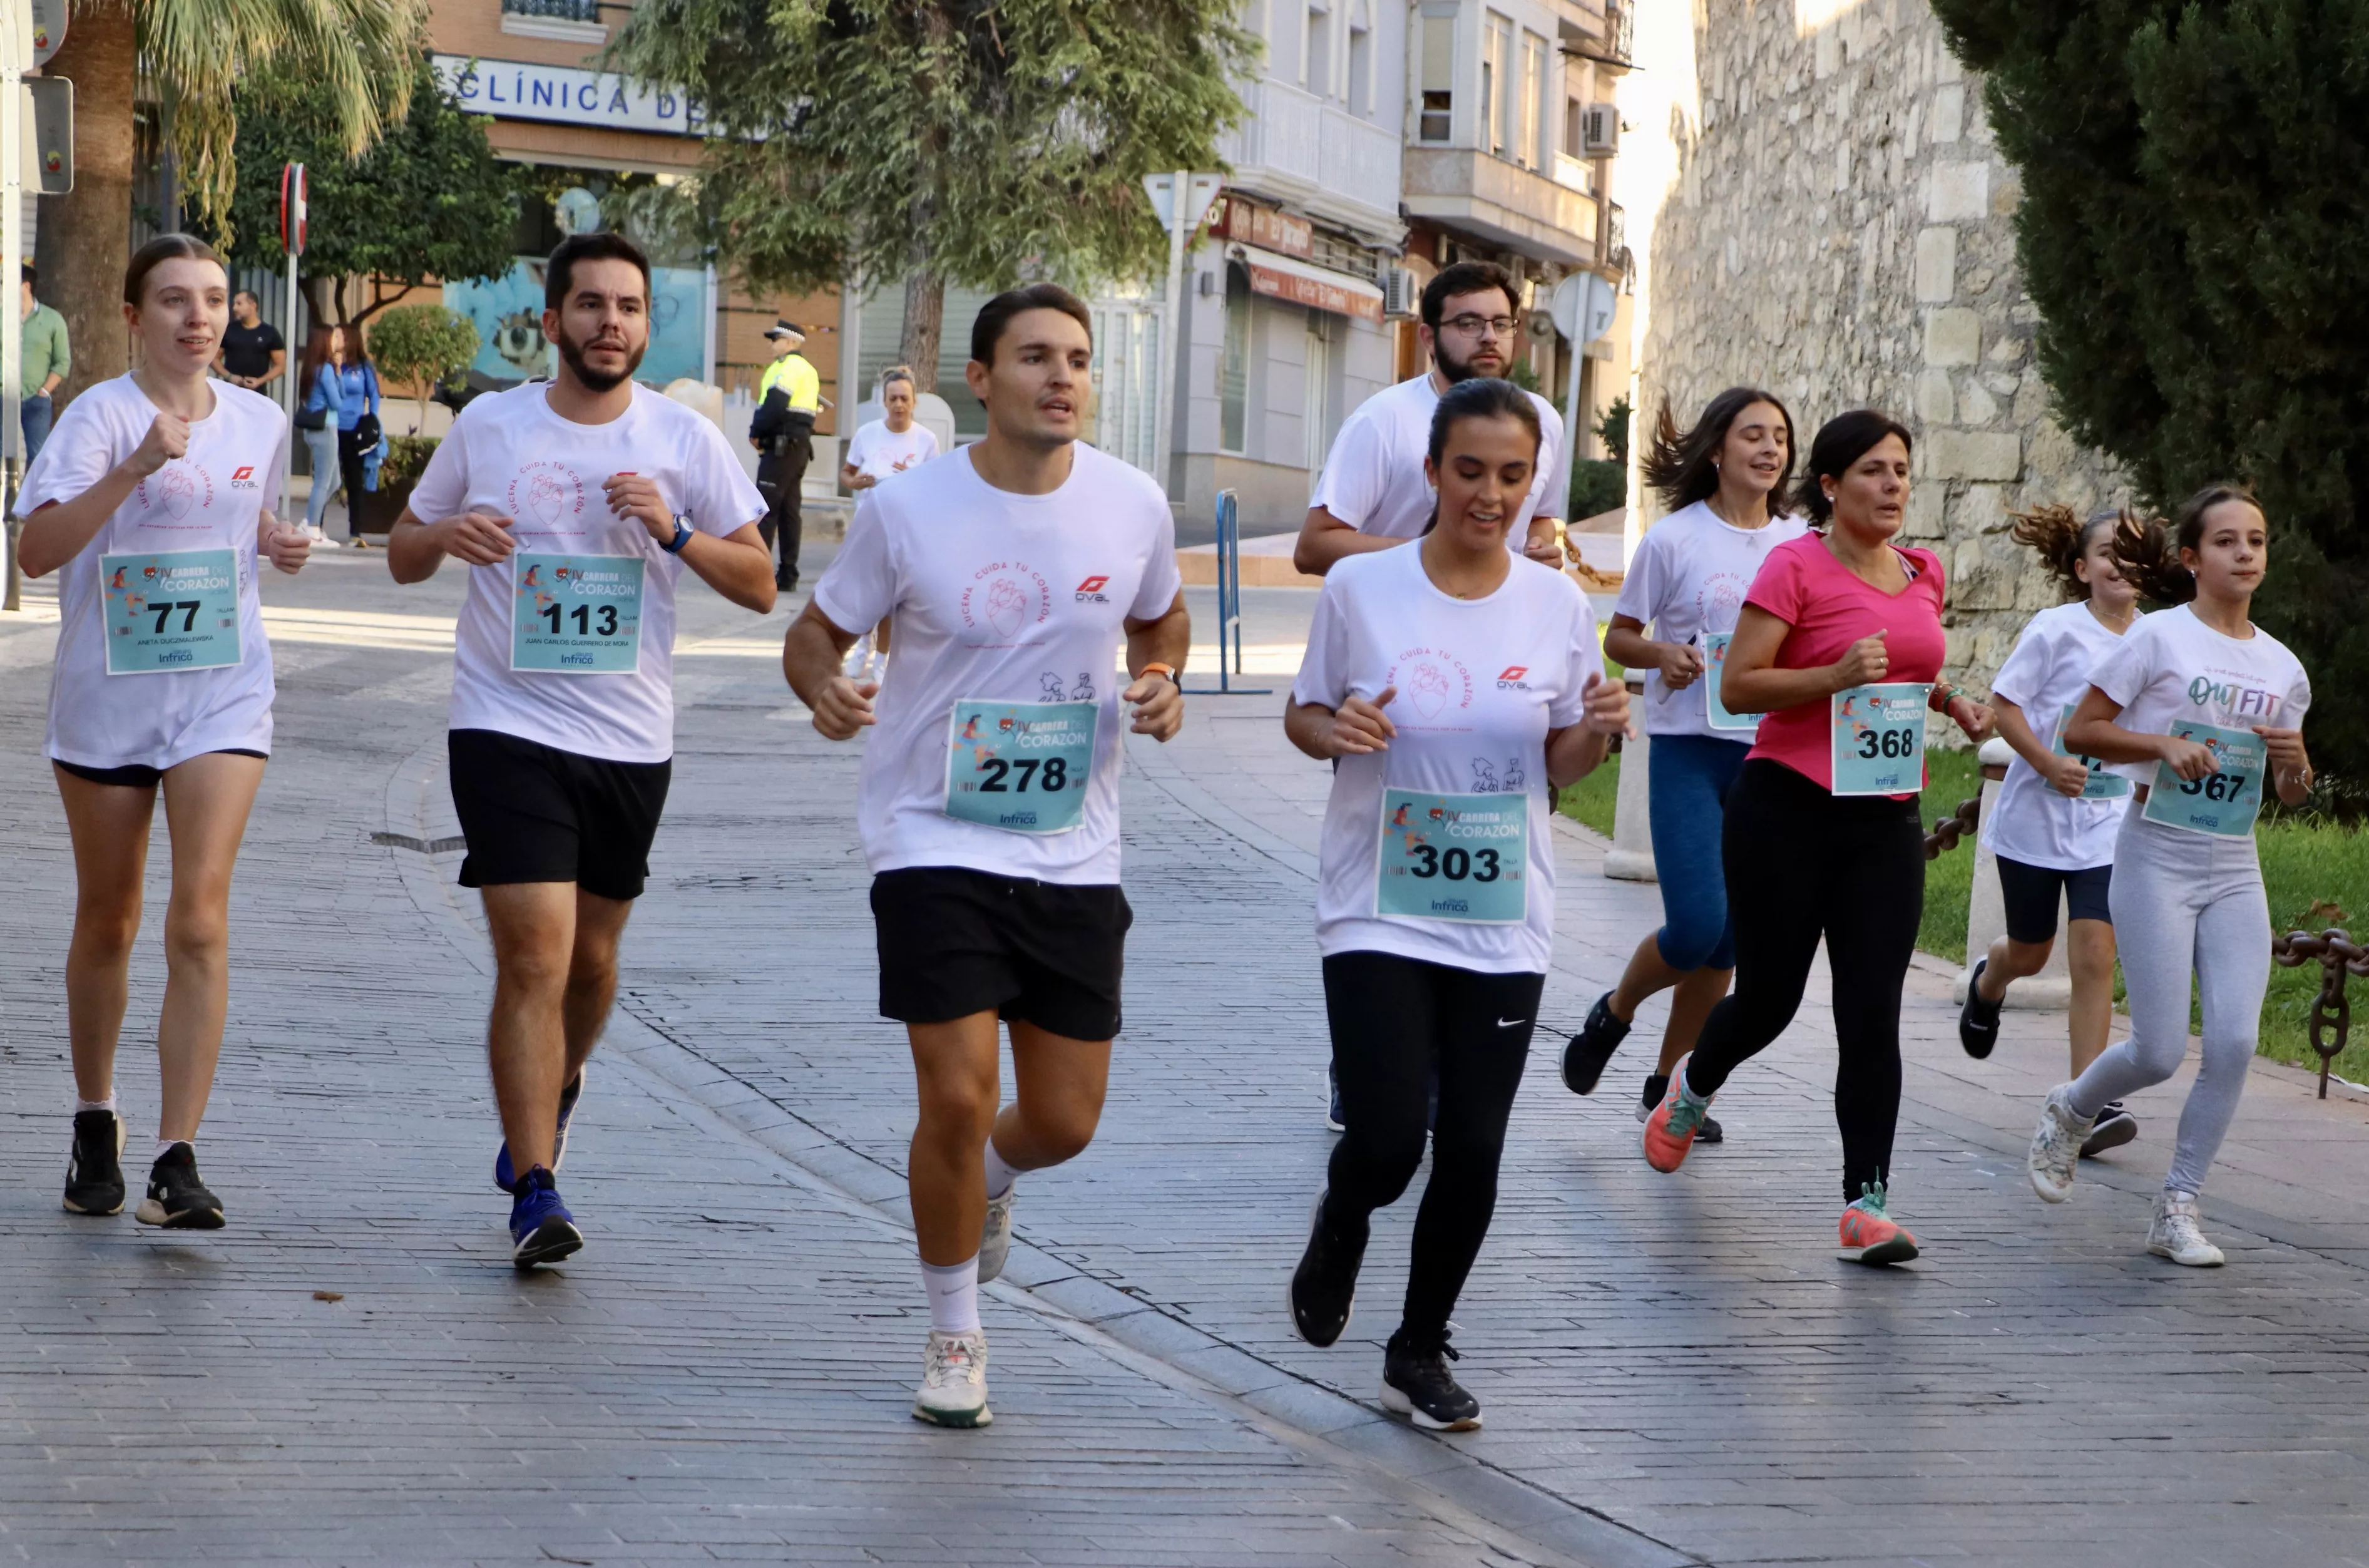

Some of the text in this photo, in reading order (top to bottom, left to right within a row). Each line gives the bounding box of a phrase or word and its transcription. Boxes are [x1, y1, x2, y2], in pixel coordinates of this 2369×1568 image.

[458, 71, 629, 114] CLÍNICA
[508, 478, 519, 515] LUCENA
[520, 461, 547, 474] CUIDA
[553, 461, 565, 471] TU
[961, 587, 975, 628] LUCENA
[975, 562, 1007, 580] CUIDA
[1016, 562, 1028, 573] TU
[147, 600, 202, 634] 77
[543, 603, 618, 637] 113
[159, 653, 193, 663] Infrico
[561, 653, 593, 664] Infrico
[1399, 647, 1431, 661] CUIDA
[1438, 650, 1451, 660] TU
[1858, 728, 1913, 759] 368
[979, 757, 1067, 792] 278
[1000, 814, 1037, 824] Infrico
[2189, 814, 2219, 828] Infrico
[1411, 844, 1500, 883] 303
[1431, 899, 1469, 913] Infrico
